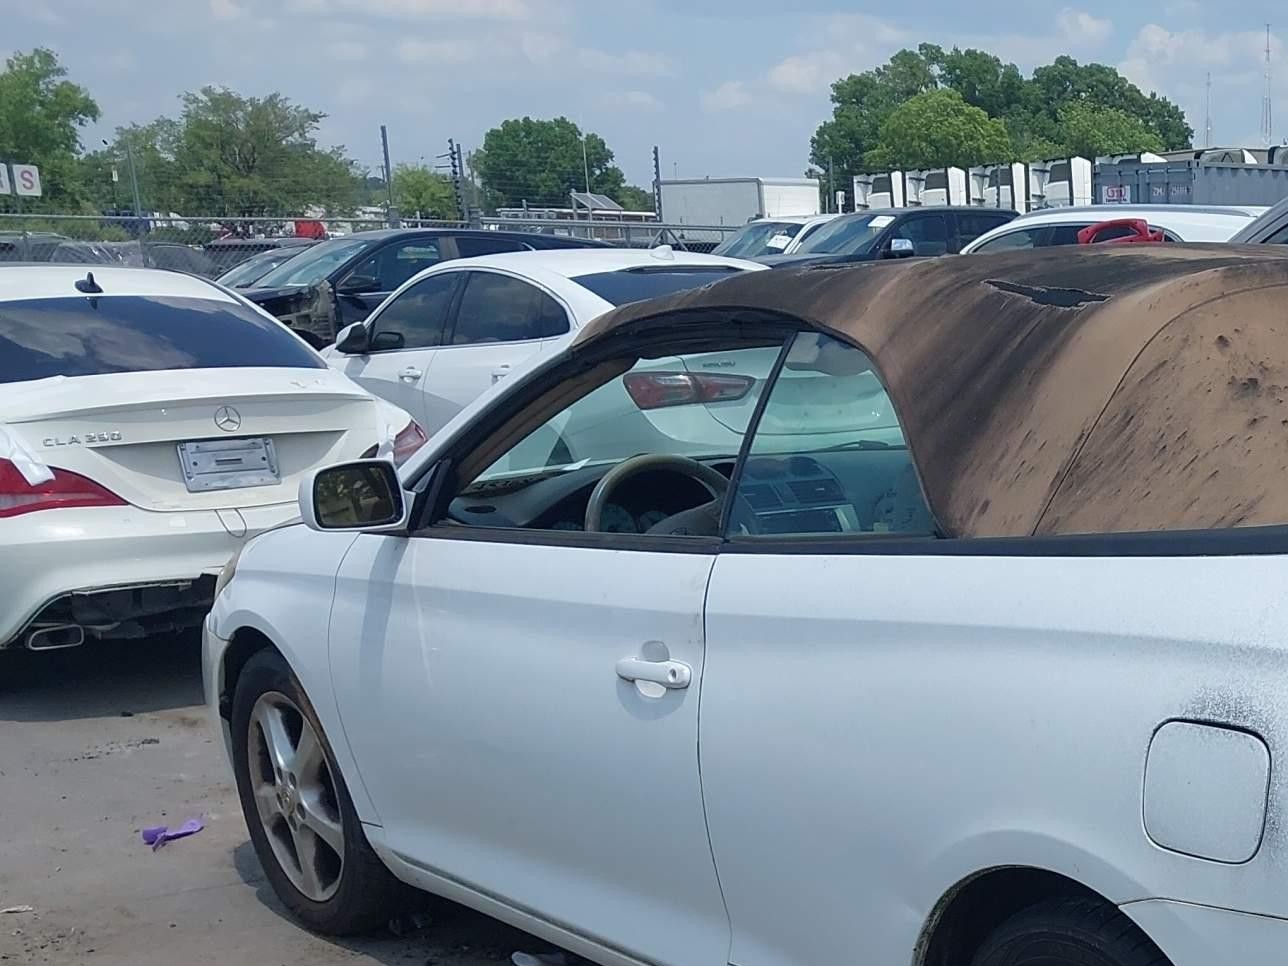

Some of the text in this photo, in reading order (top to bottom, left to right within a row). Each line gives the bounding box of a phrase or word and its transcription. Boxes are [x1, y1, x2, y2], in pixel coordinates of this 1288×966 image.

[20, 170, 35, 190] S
[43, 431, 123, 447] CLA 250
